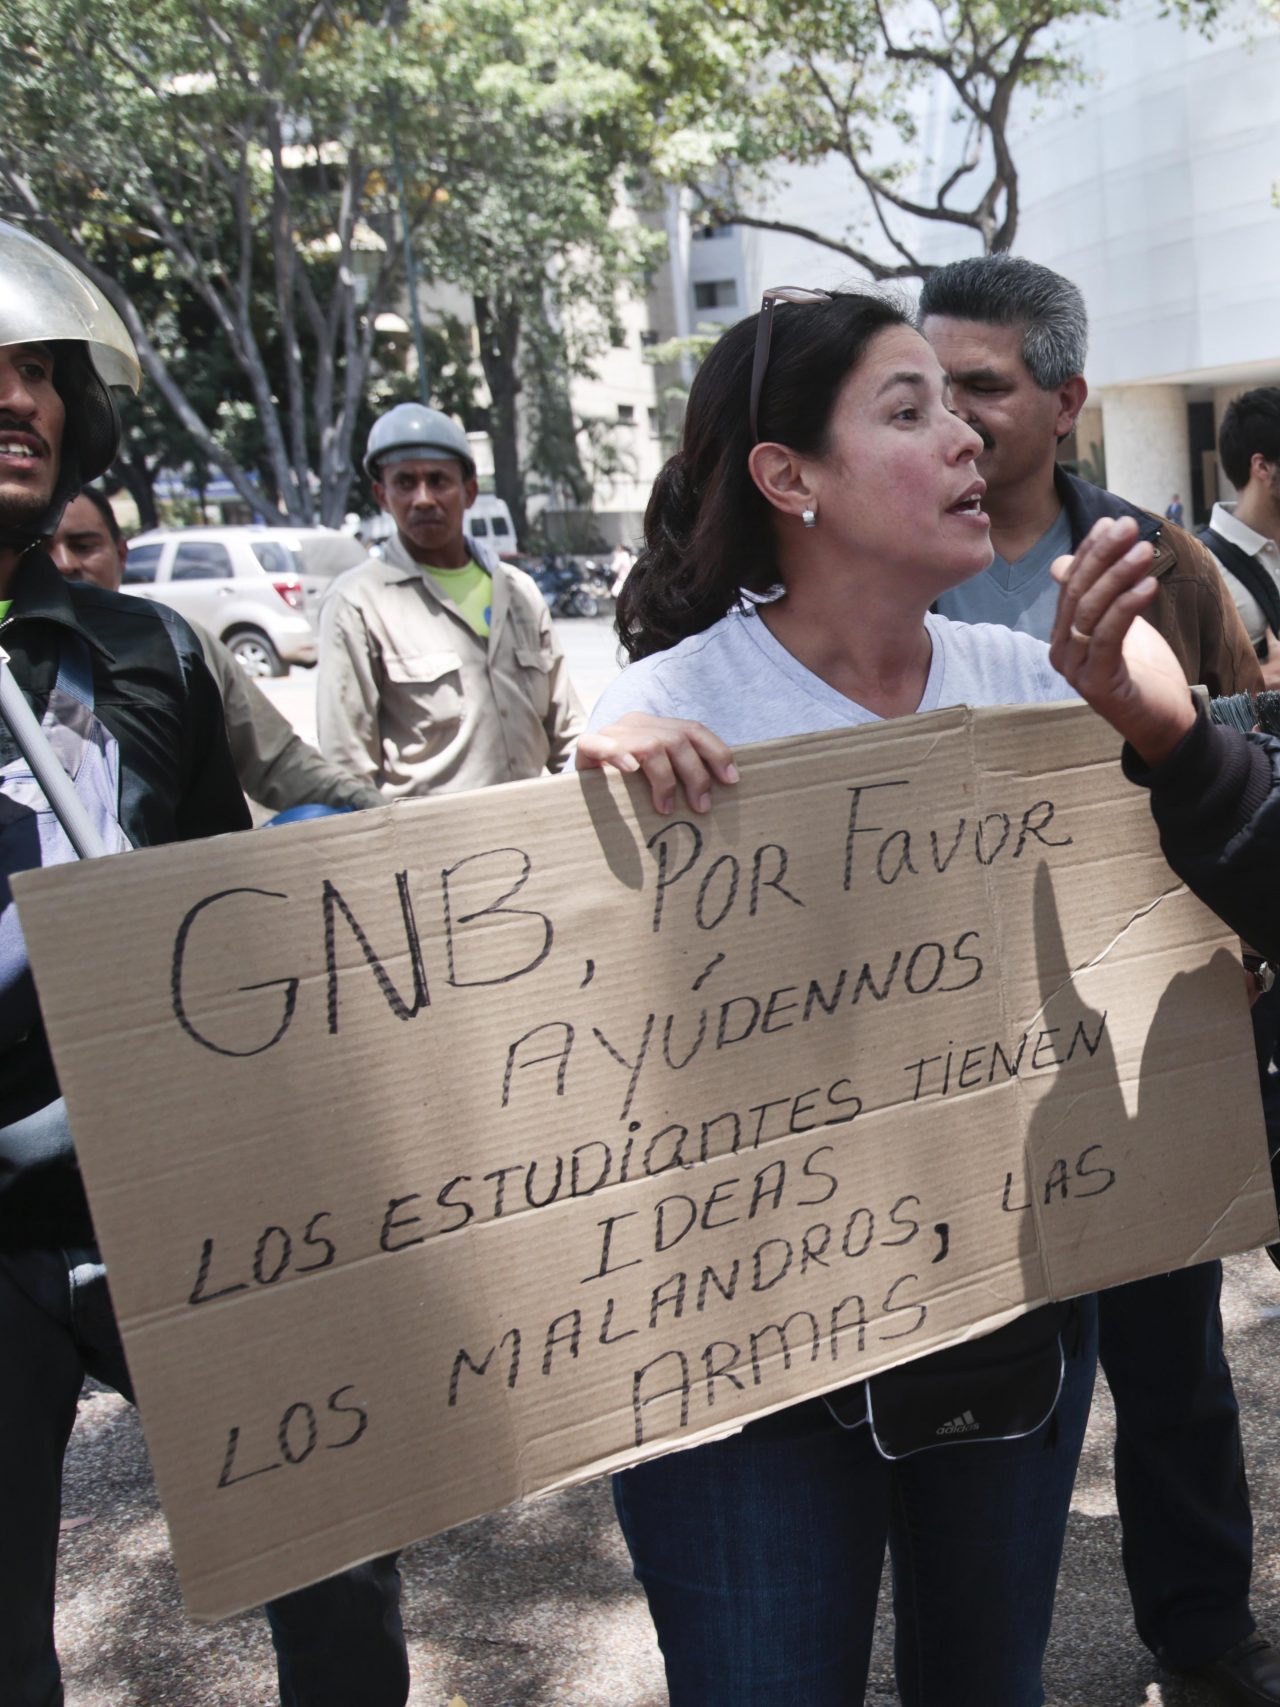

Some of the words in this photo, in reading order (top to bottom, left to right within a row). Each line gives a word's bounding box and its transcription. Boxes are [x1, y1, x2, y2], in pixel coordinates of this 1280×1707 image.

[170, 847, 595, 1057] GNB,
[646, 820, 805, 933] POR
[188, 1211, 335, 1304] LOS
[579, 1145, 839, 1284] IDEAS
[216, 1385, 368, 1488] LOS
[448, 1195, 949, 1407] MALANDROS,
[1002, 1143, 1116, 1213] LAS
[632, 1273, 928, 1447] ARMAS
[935, 1421, 981, 1435] adidas
